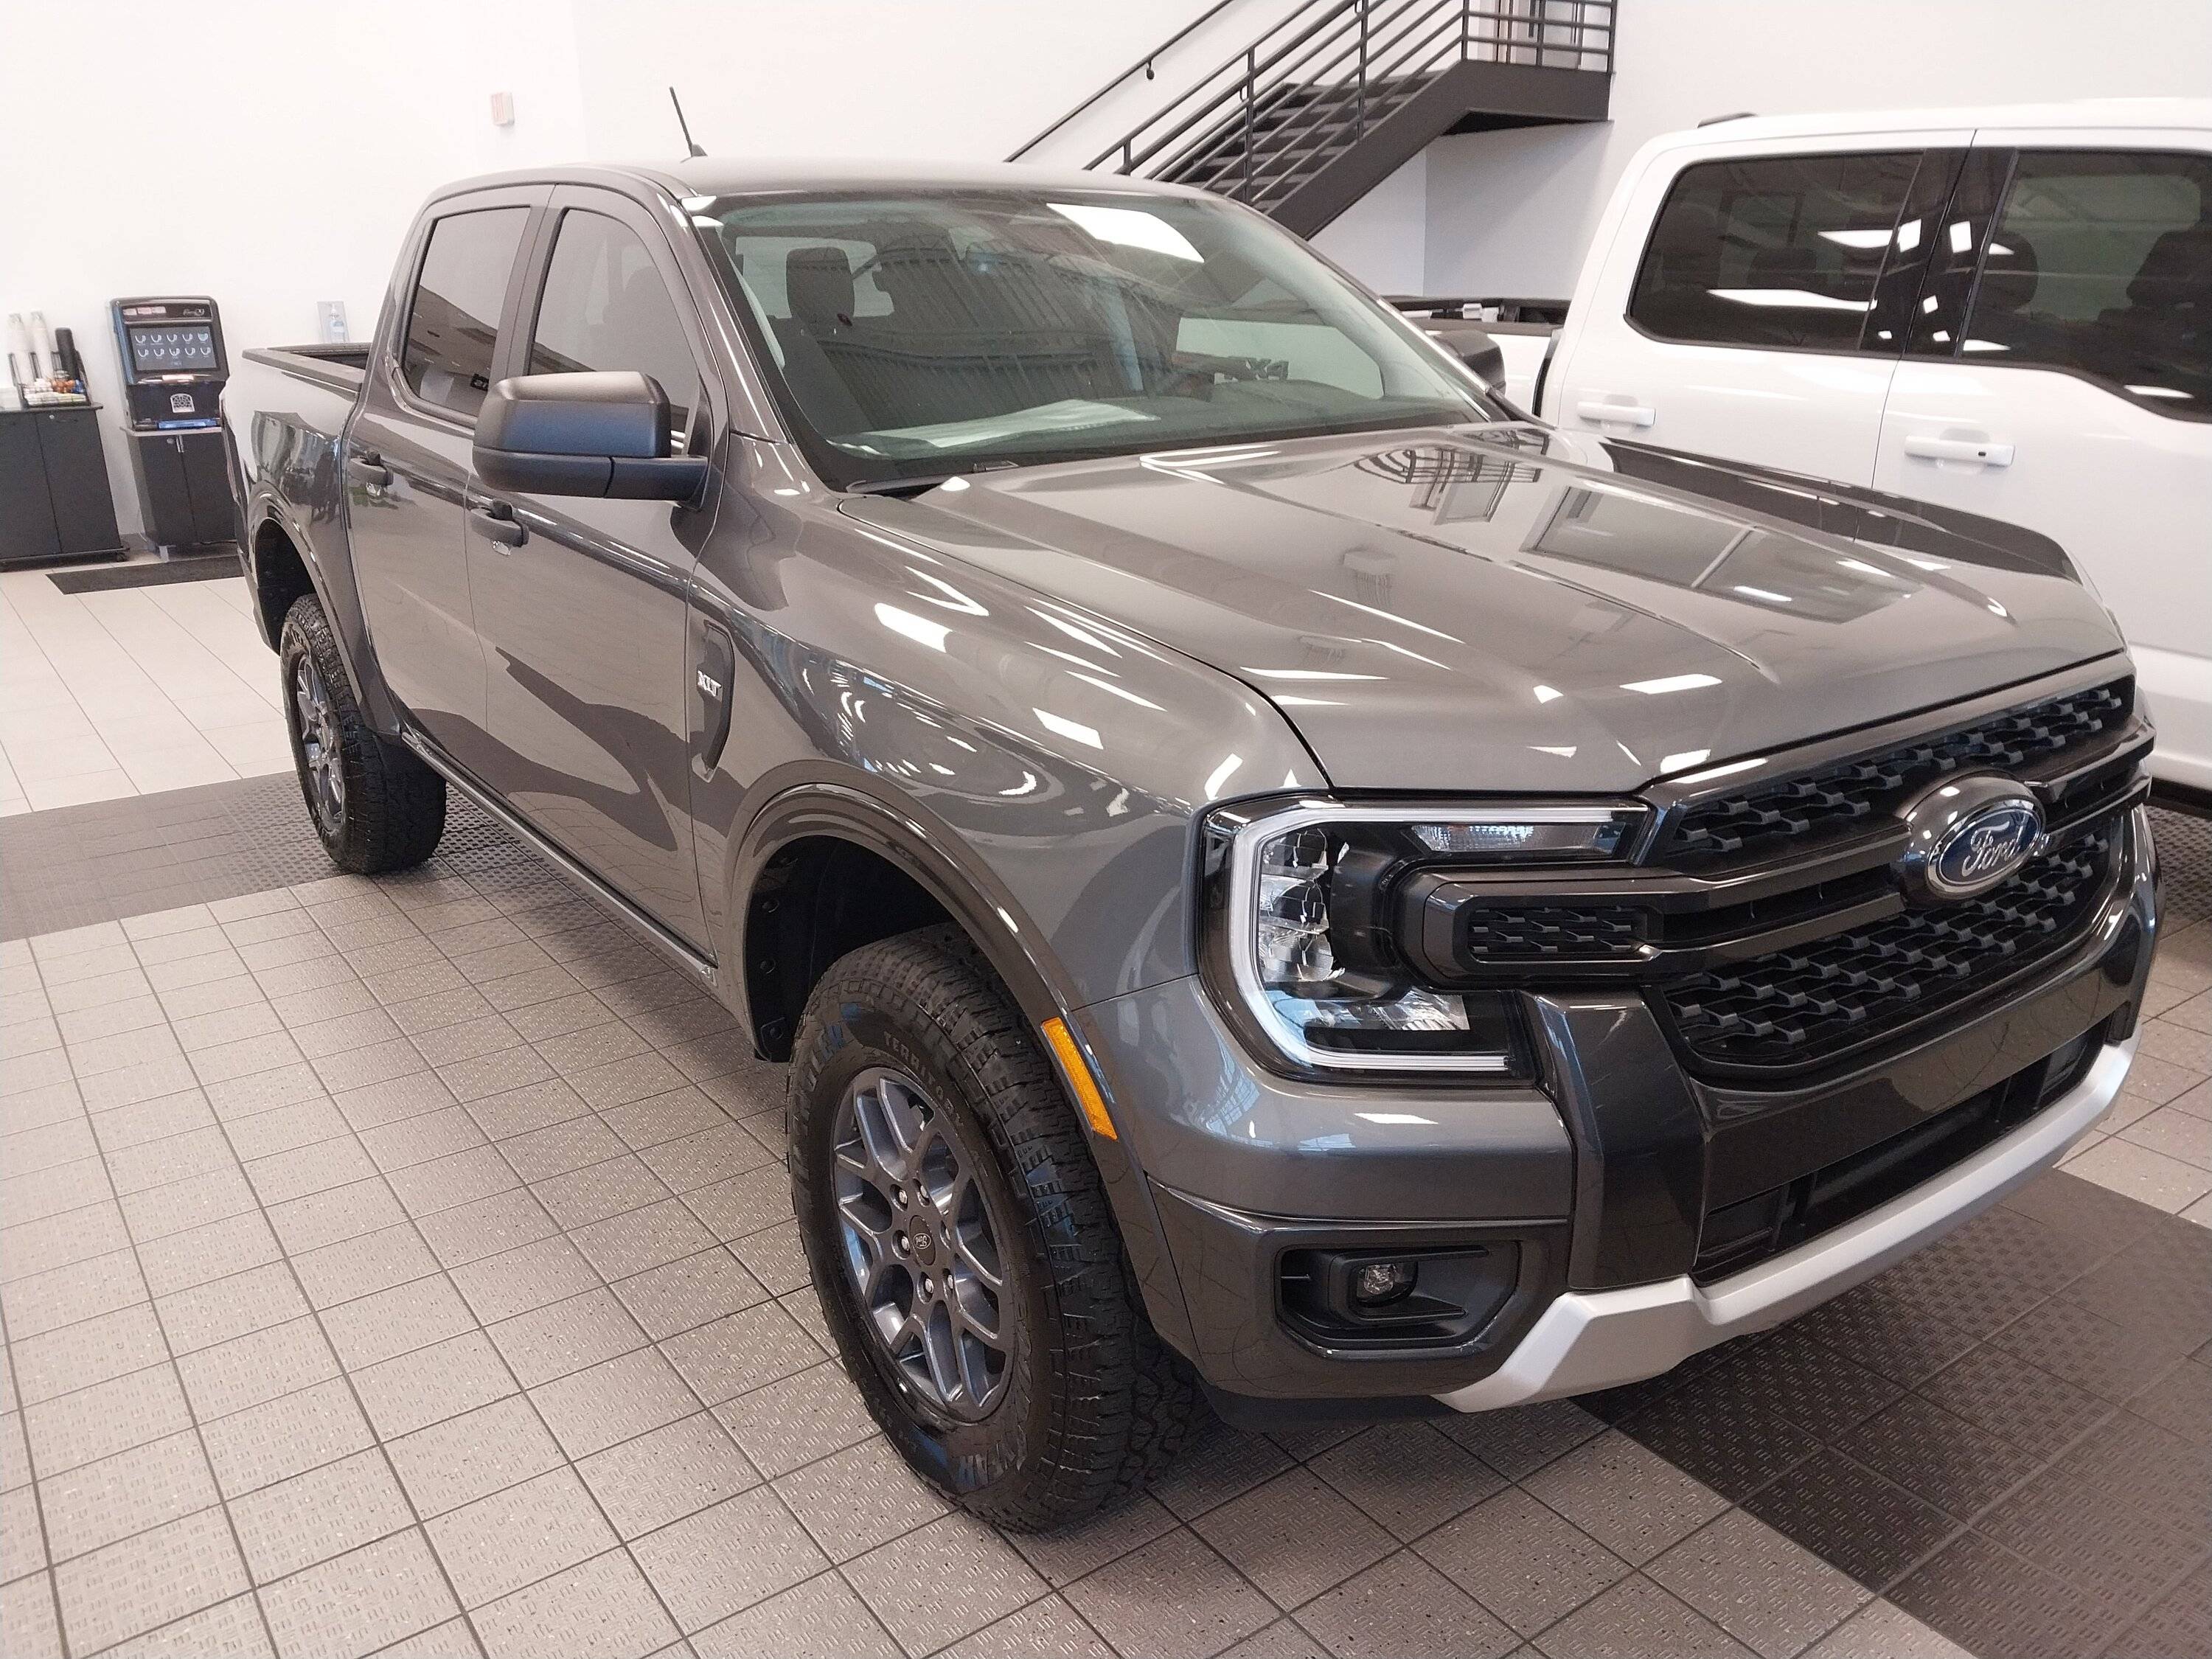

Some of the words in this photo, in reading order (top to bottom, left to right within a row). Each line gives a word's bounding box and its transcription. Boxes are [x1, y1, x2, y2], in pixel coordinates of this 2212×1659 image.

[697, 670, 722, 697] XLT
[1961, 820, 2023, 877] Ford
[883, 1030, 965, 1127] TERRITORY
